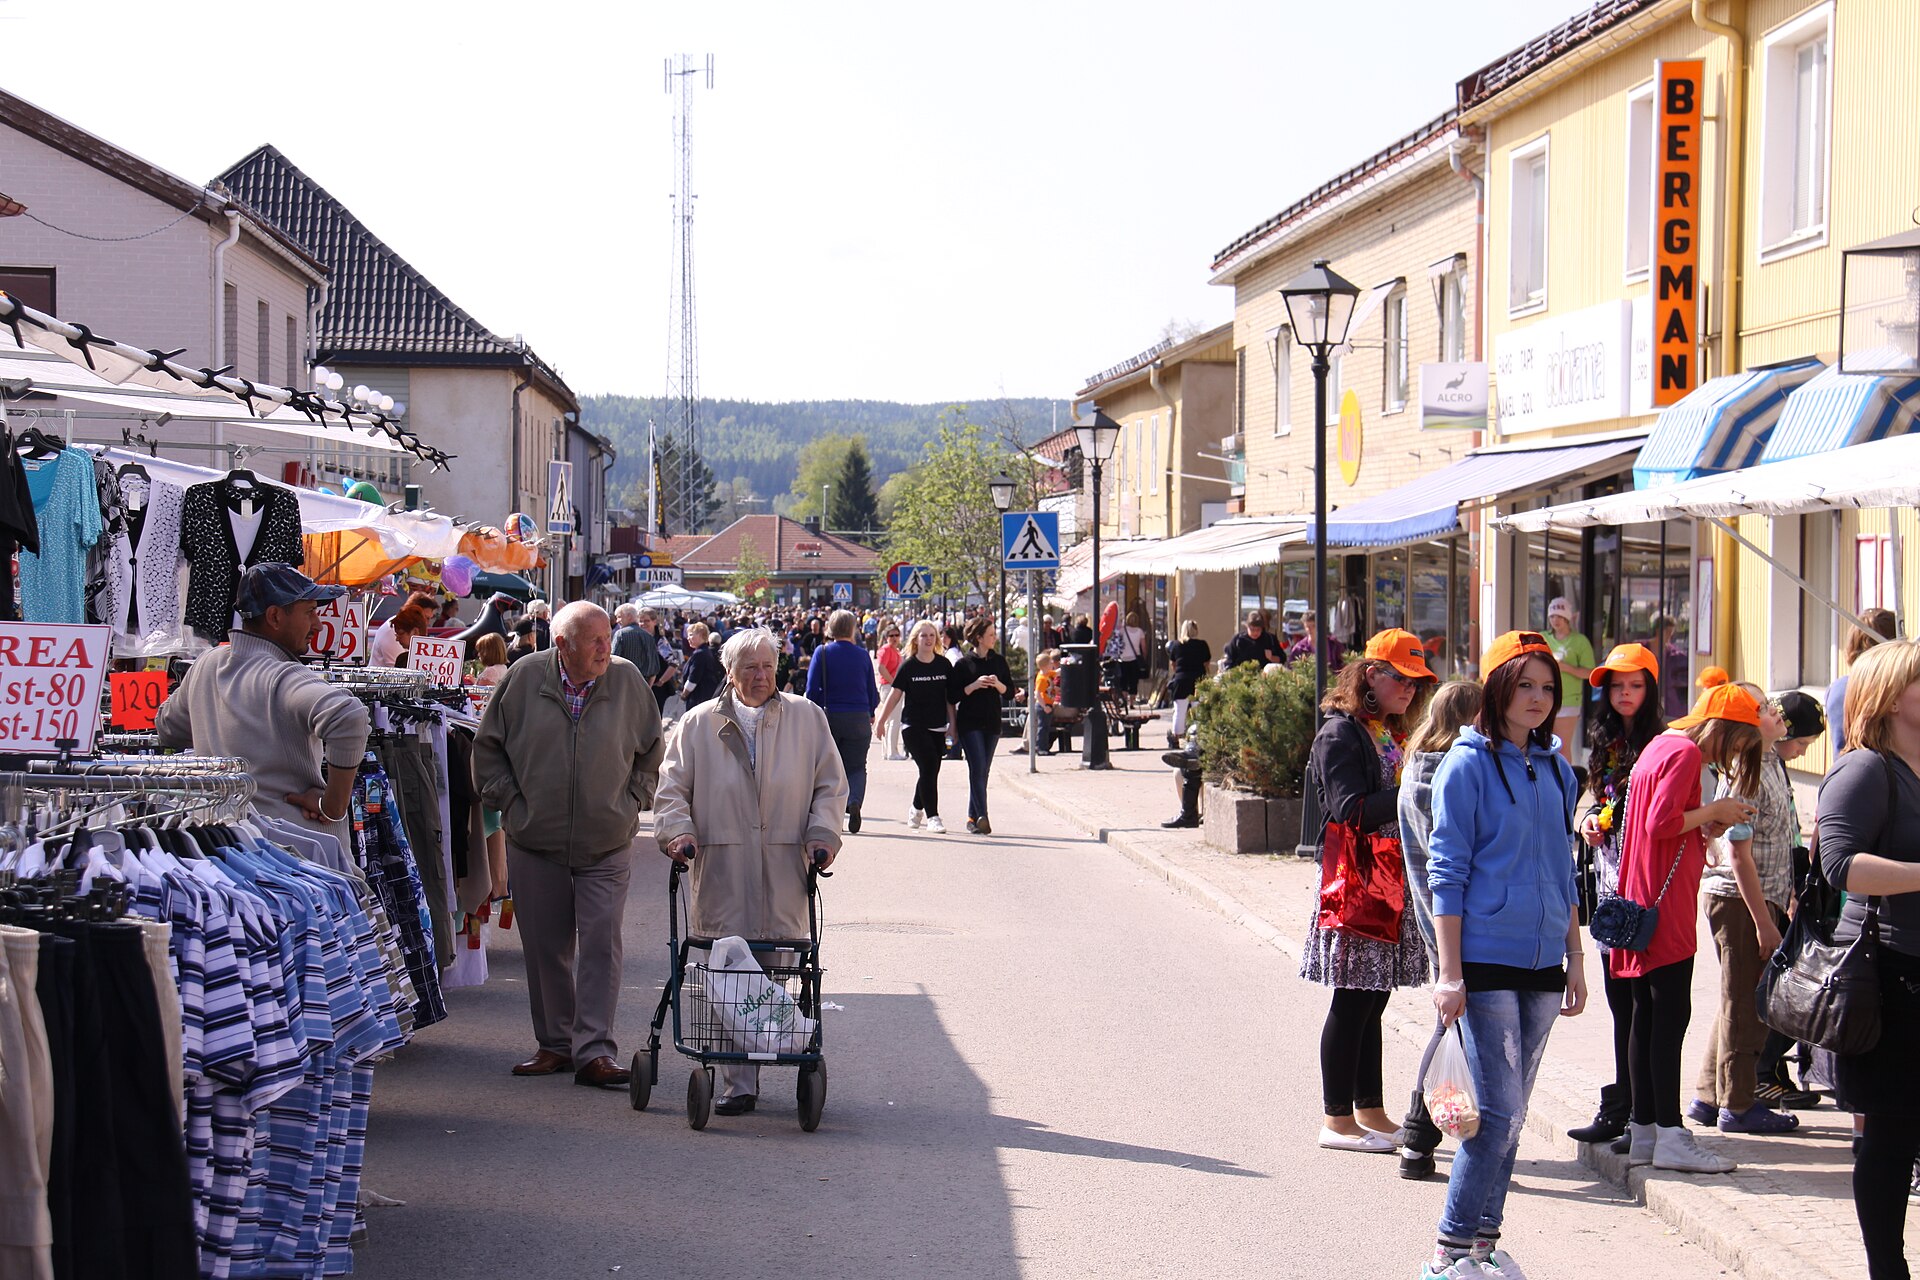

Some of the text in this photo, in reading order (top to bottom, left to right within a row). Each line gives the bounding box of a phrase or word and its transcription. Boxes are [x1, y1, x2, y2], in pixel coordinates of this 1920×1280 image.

[1659, 78, 1694, 390] BERGMAN
[1437, 393, 1473, 402] ALCRO
[648, 569, 673, 582] JÄRN
[0, 635, 94, 669] REA
[415, 641, 460, 659] REA
